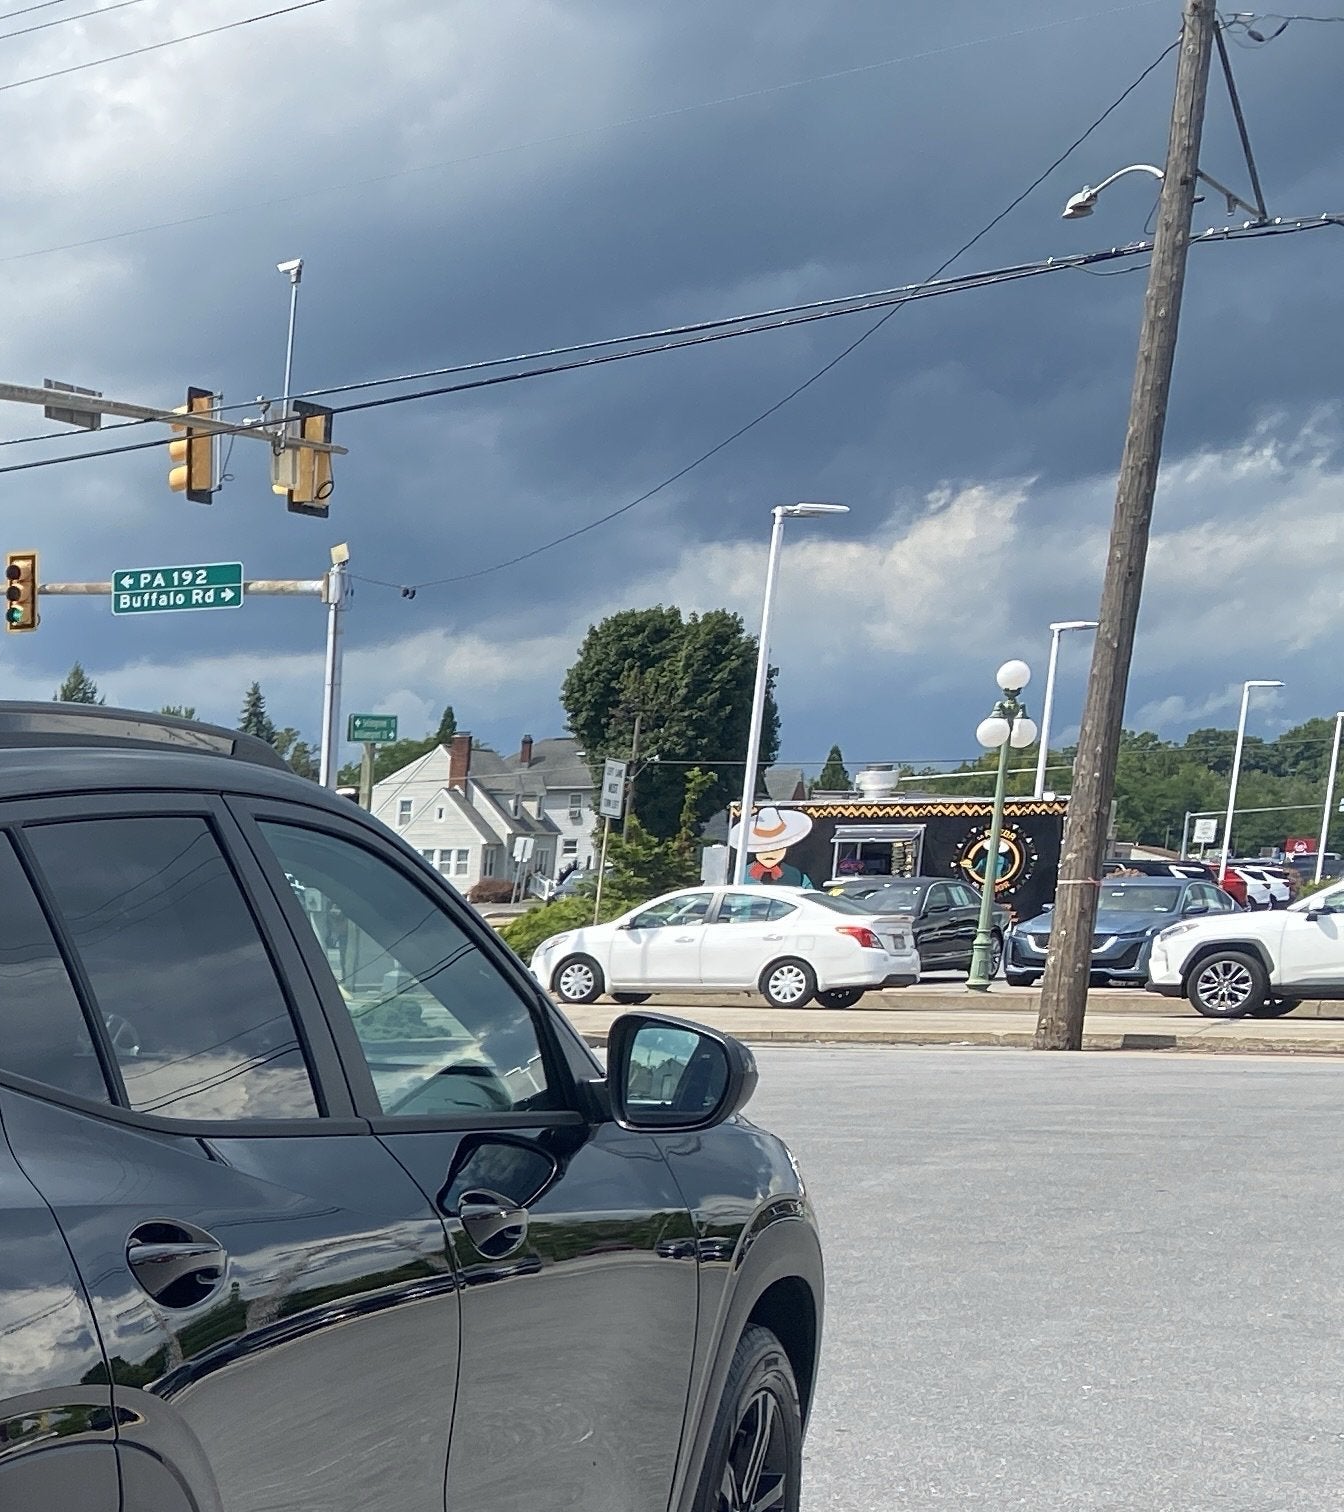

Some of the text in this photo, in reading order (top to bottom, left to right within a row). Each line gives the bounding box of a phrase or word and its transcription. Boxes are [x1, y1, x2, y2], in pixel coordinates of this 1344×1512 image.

[140, 570, 207, 588] PA 192
[119, 588, 214, 609] Buffalo Rd
